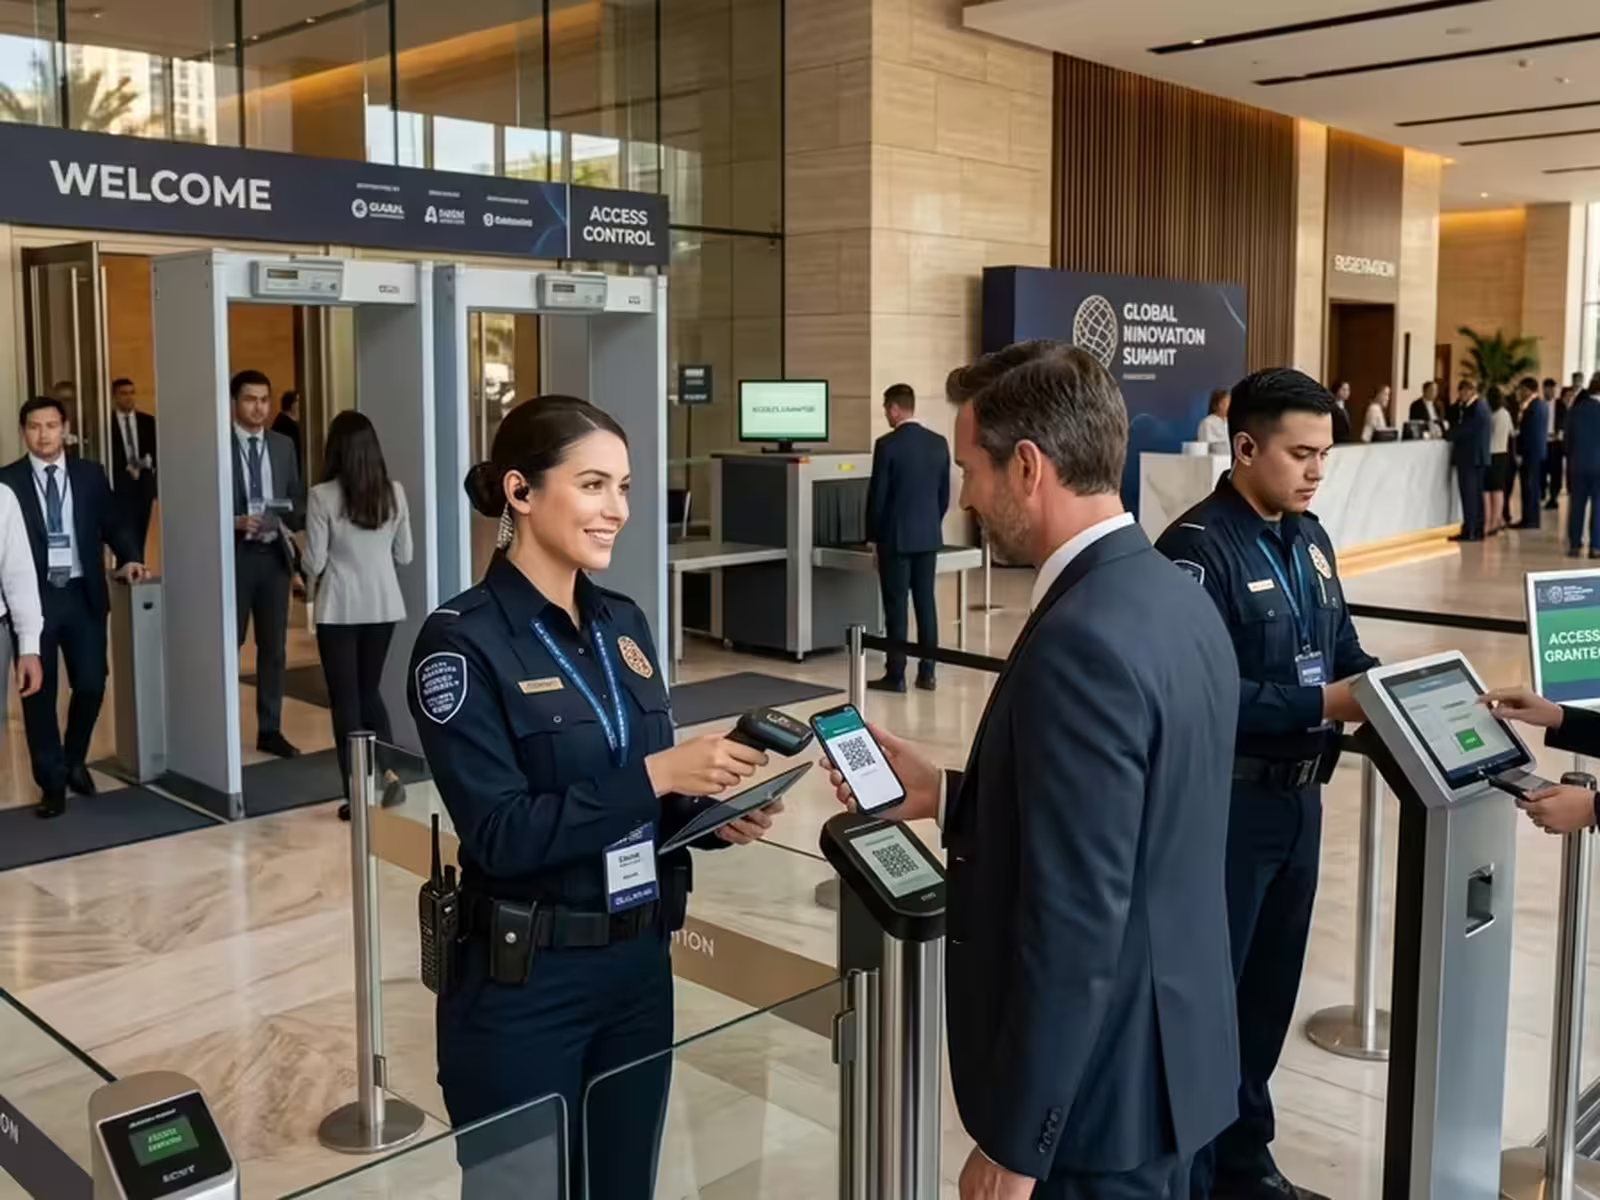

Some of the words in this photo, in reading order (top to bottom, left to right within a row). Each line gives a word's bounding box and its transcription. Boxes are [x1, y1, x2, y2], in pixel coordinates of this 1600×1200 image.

[49, 160, 272, 210] WELCOME
[589, 205, 648, 226] ACCESS
[583, 225, 655, 246] CONTROL
[1123, 302, 1177, 323] GLOBAL
[1123, 347, 1177, 366] SUMMIT
[1548, 628, 1600, 645] ACCESS
[1544, 646, 1600, 663] GRANTE
